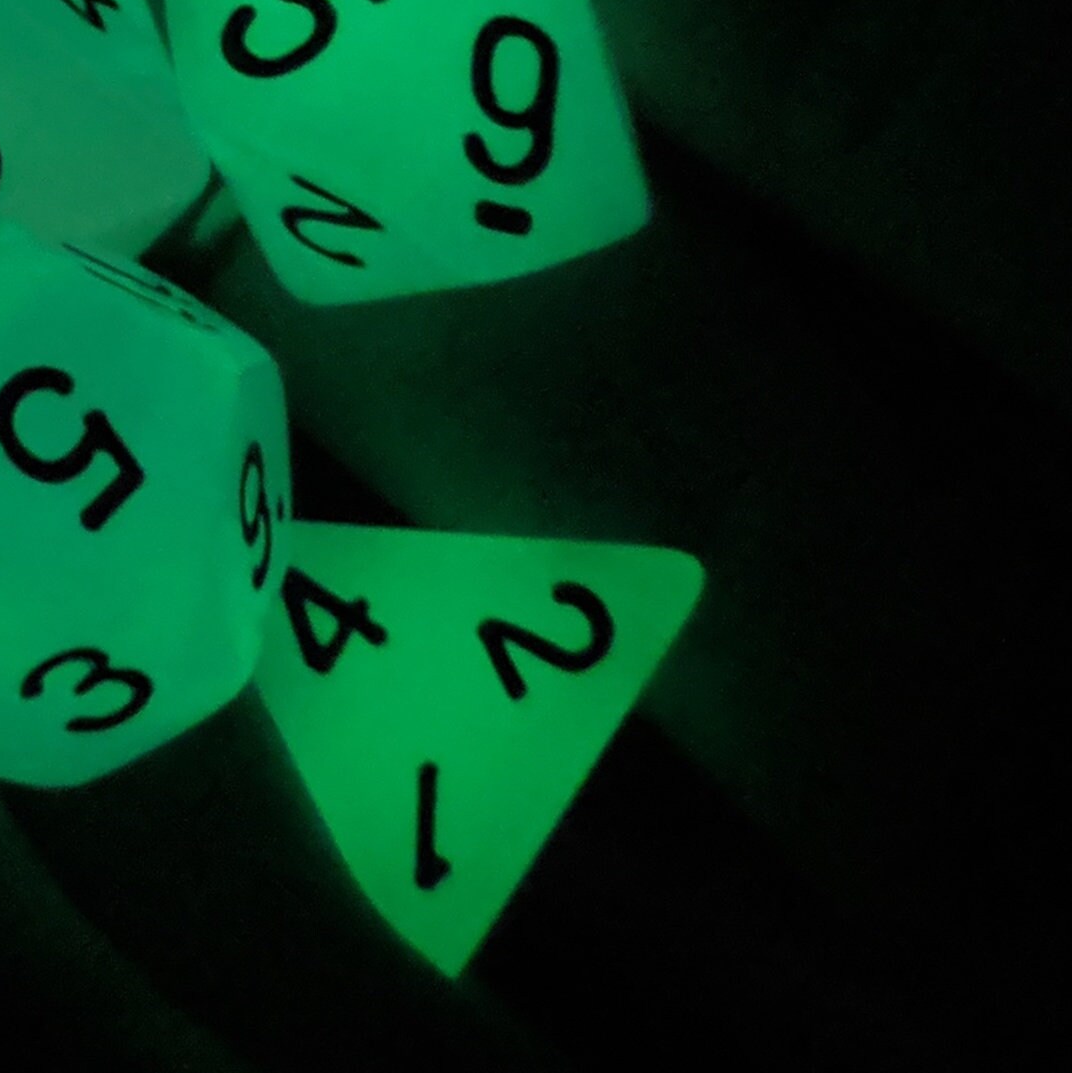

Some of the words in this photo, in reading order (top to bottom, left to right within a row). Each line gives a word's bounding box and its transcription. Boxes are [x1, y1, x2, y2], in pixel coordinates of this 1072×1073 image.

[280, 565, 388, 675] 4
[477, 580, 616, 701] 2
[20, 647, 154, 734] 3
[413, 762, 452, 891] 1
